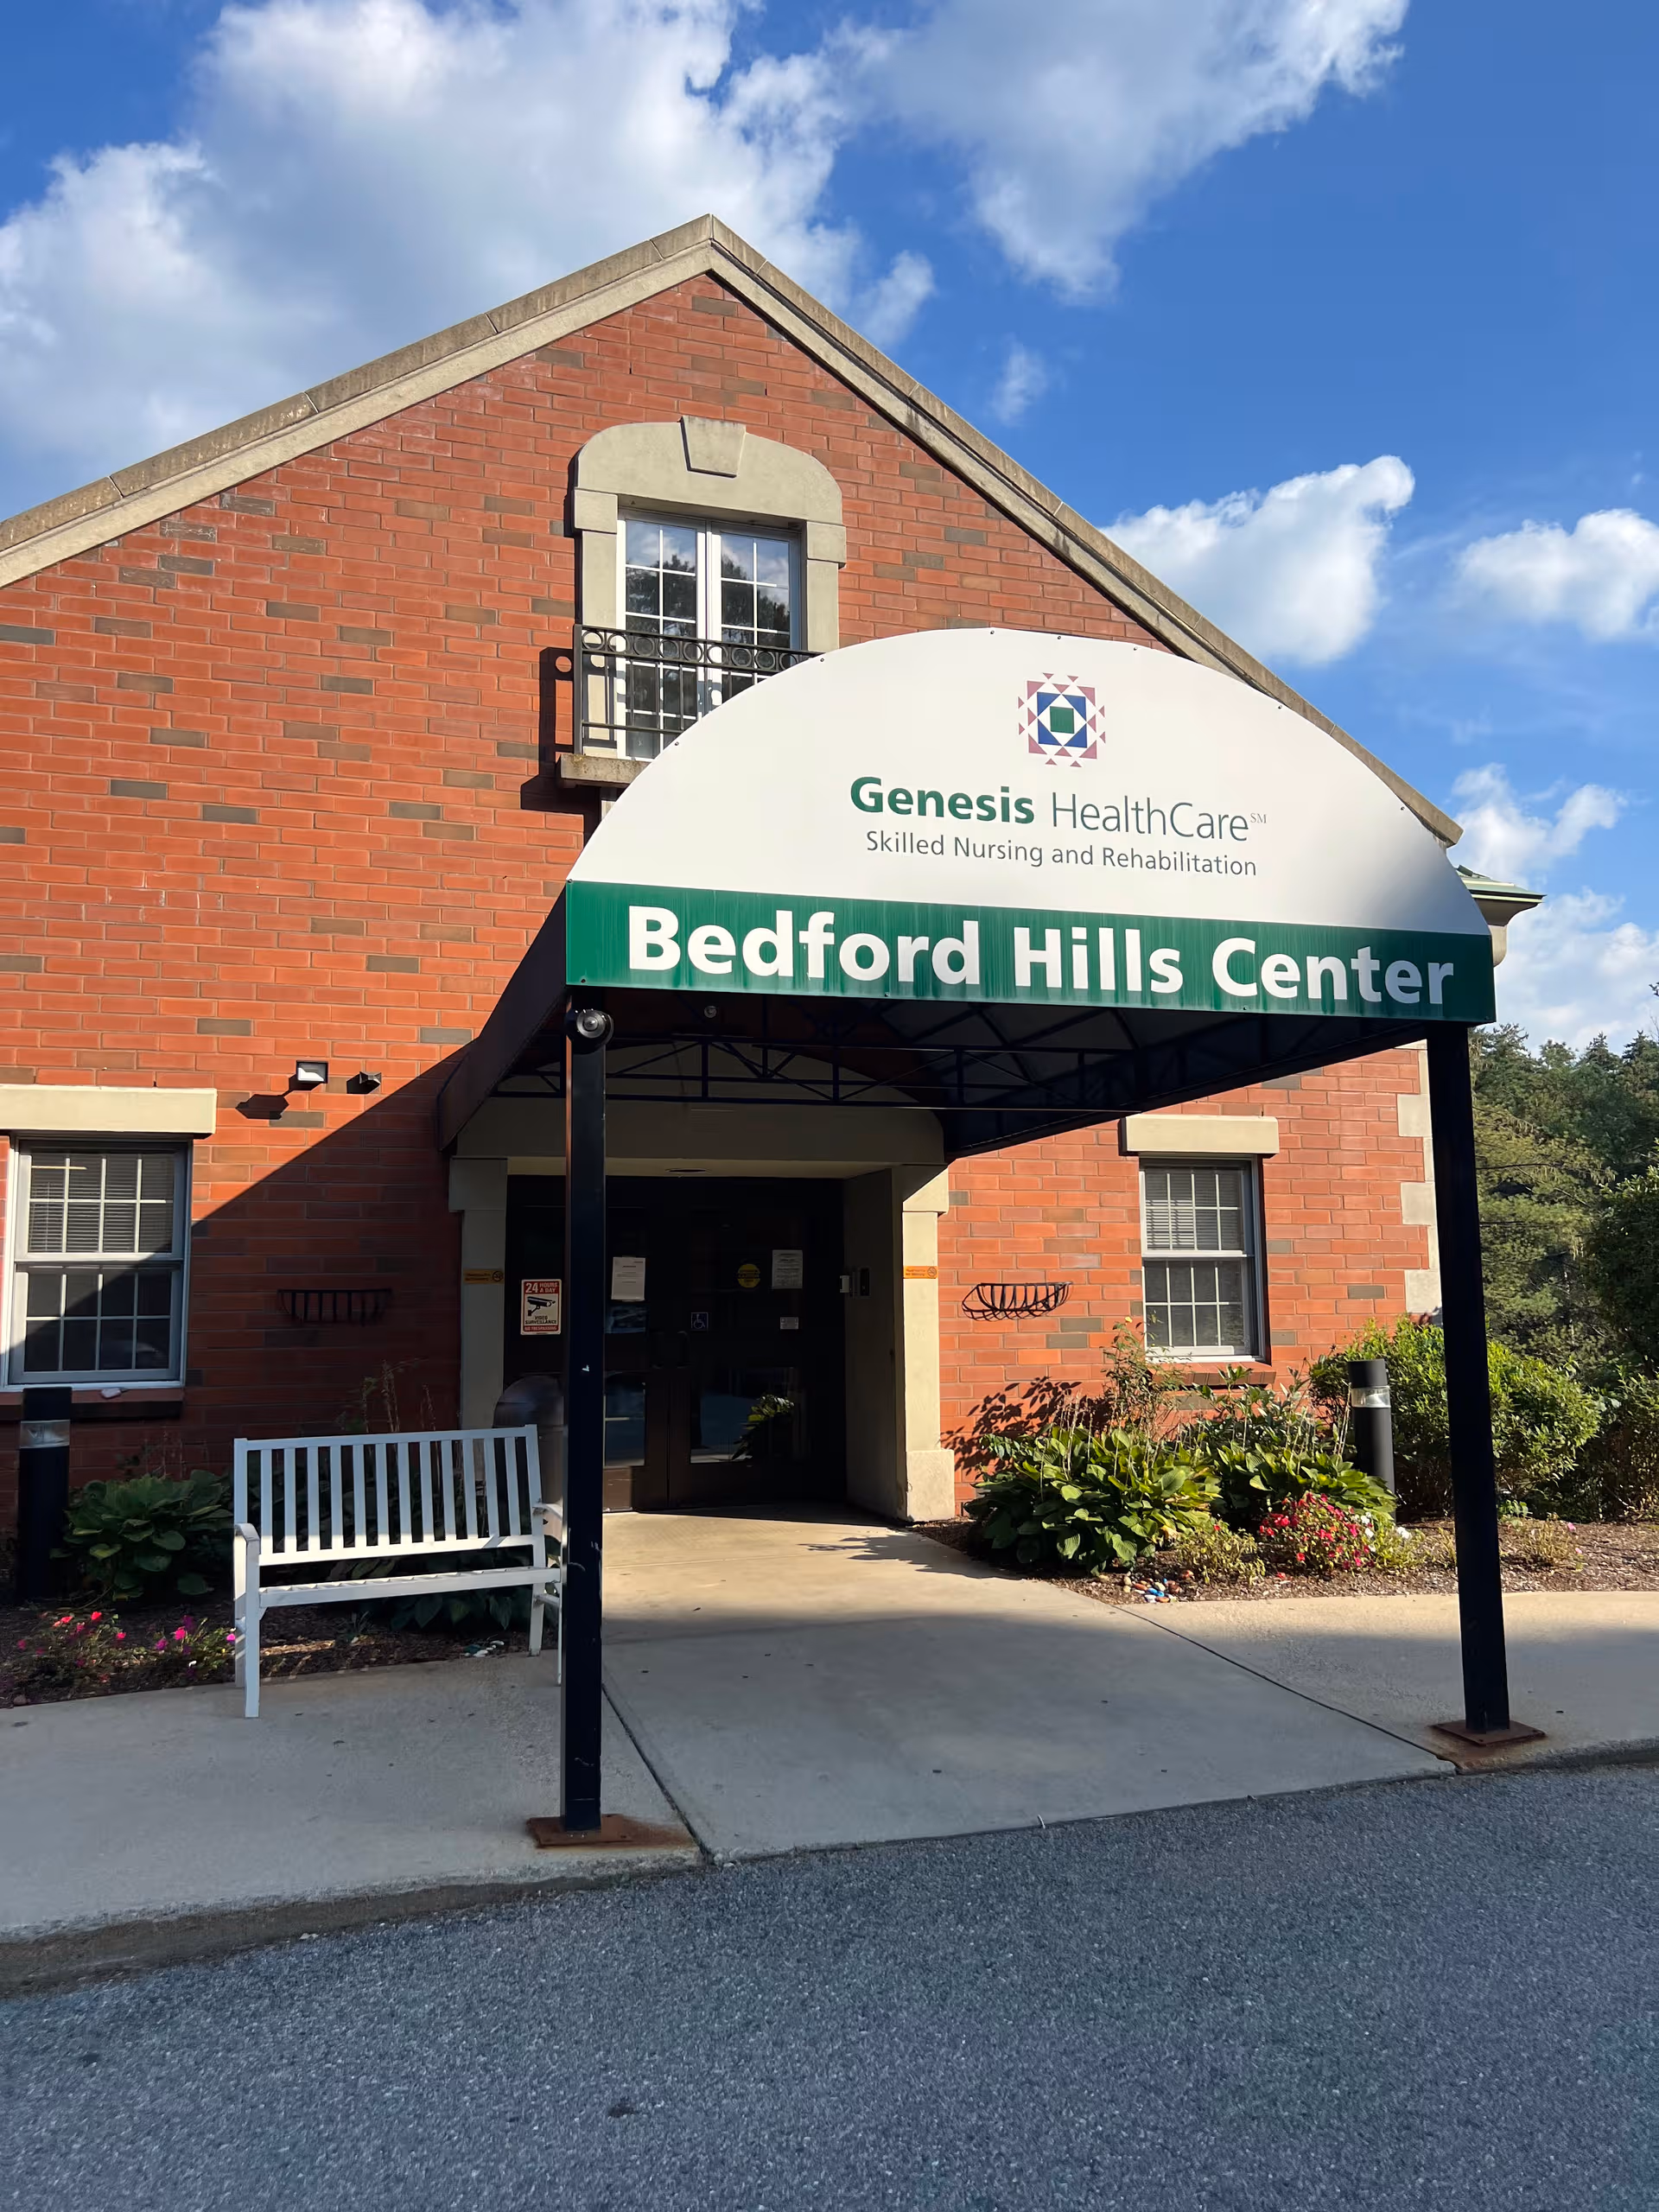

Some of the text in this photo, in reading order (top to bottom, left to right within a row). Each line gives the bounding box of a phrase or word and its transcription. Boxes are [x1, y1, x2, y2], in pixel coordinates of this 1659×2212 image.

[850, 776, 1035, 824] Genesis
[867, 830, 1256, 876] Skilled Nursing and Rehabilitation
[628, 905, 1455, 1006] Bedford Hills Center
[525, 1282, 538, 1294] 24
